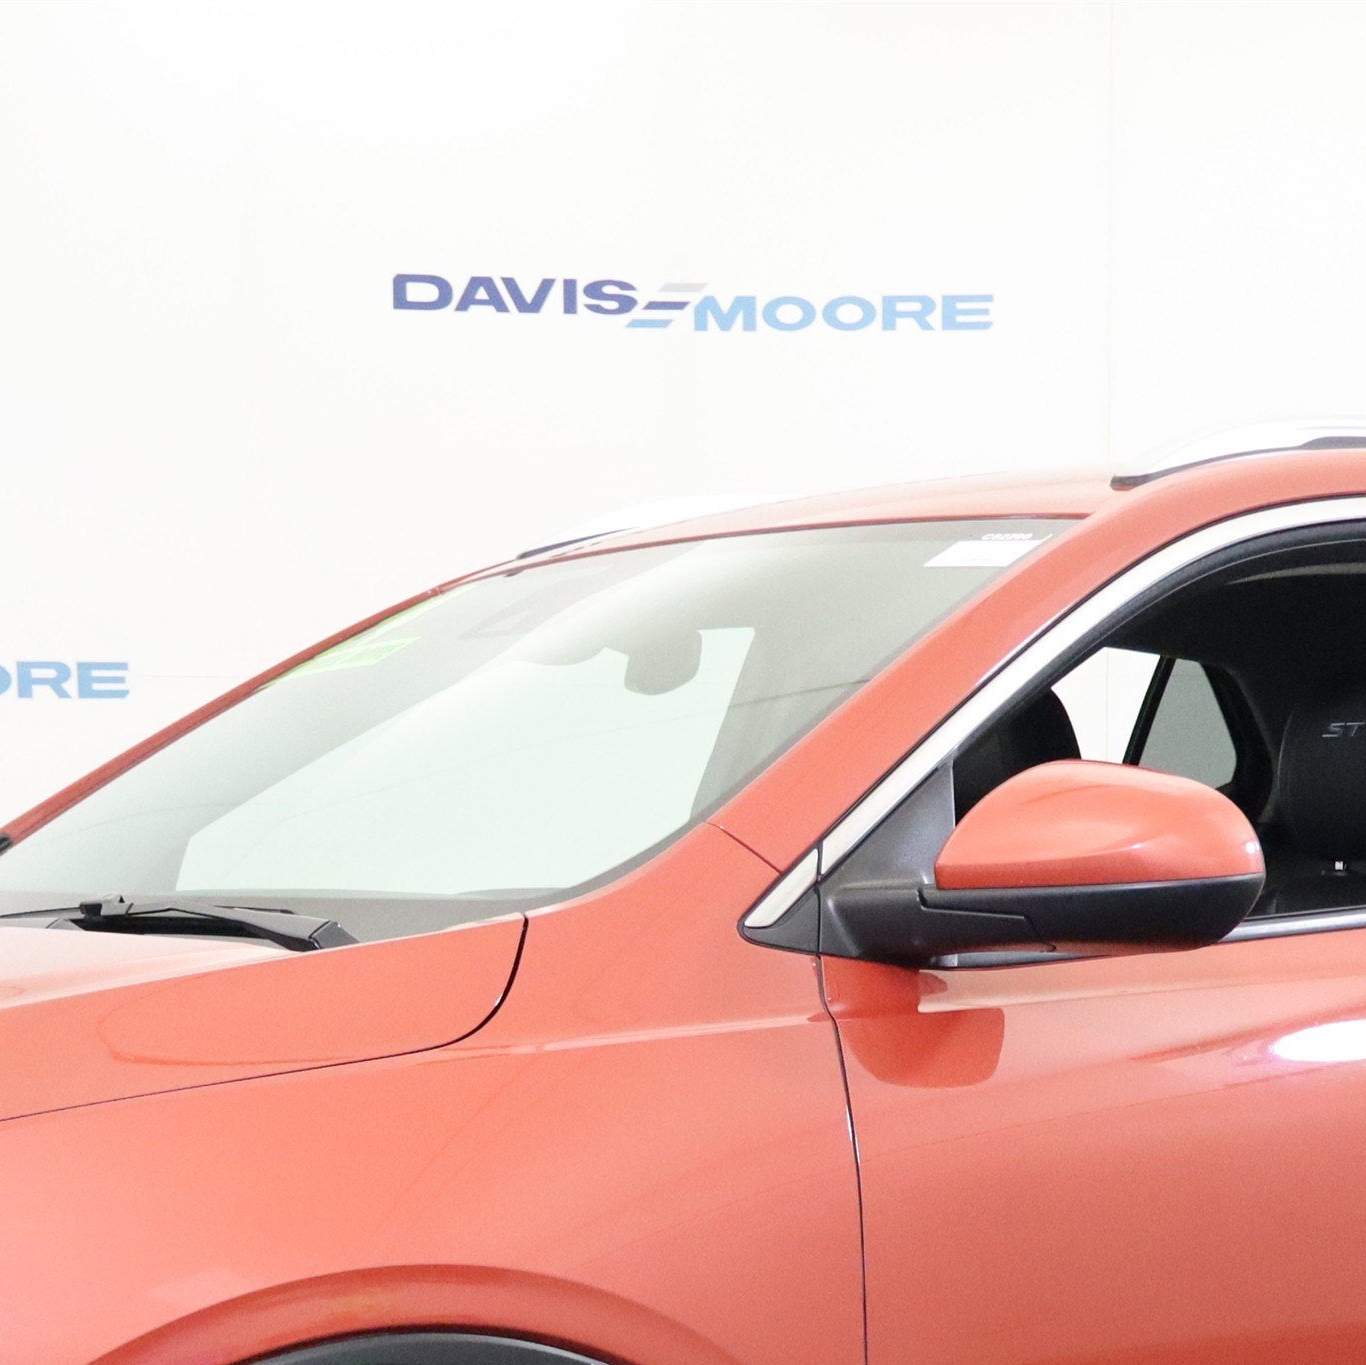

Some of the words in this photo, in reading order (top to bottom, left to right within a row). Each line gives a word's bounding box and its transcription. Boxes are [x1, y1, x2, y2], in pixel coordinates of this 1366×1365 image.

[393, 274, 638, 316] DAVIS
[693, 294, 995, 333] MOORE
[1322, 721, 1366, 738] ST
